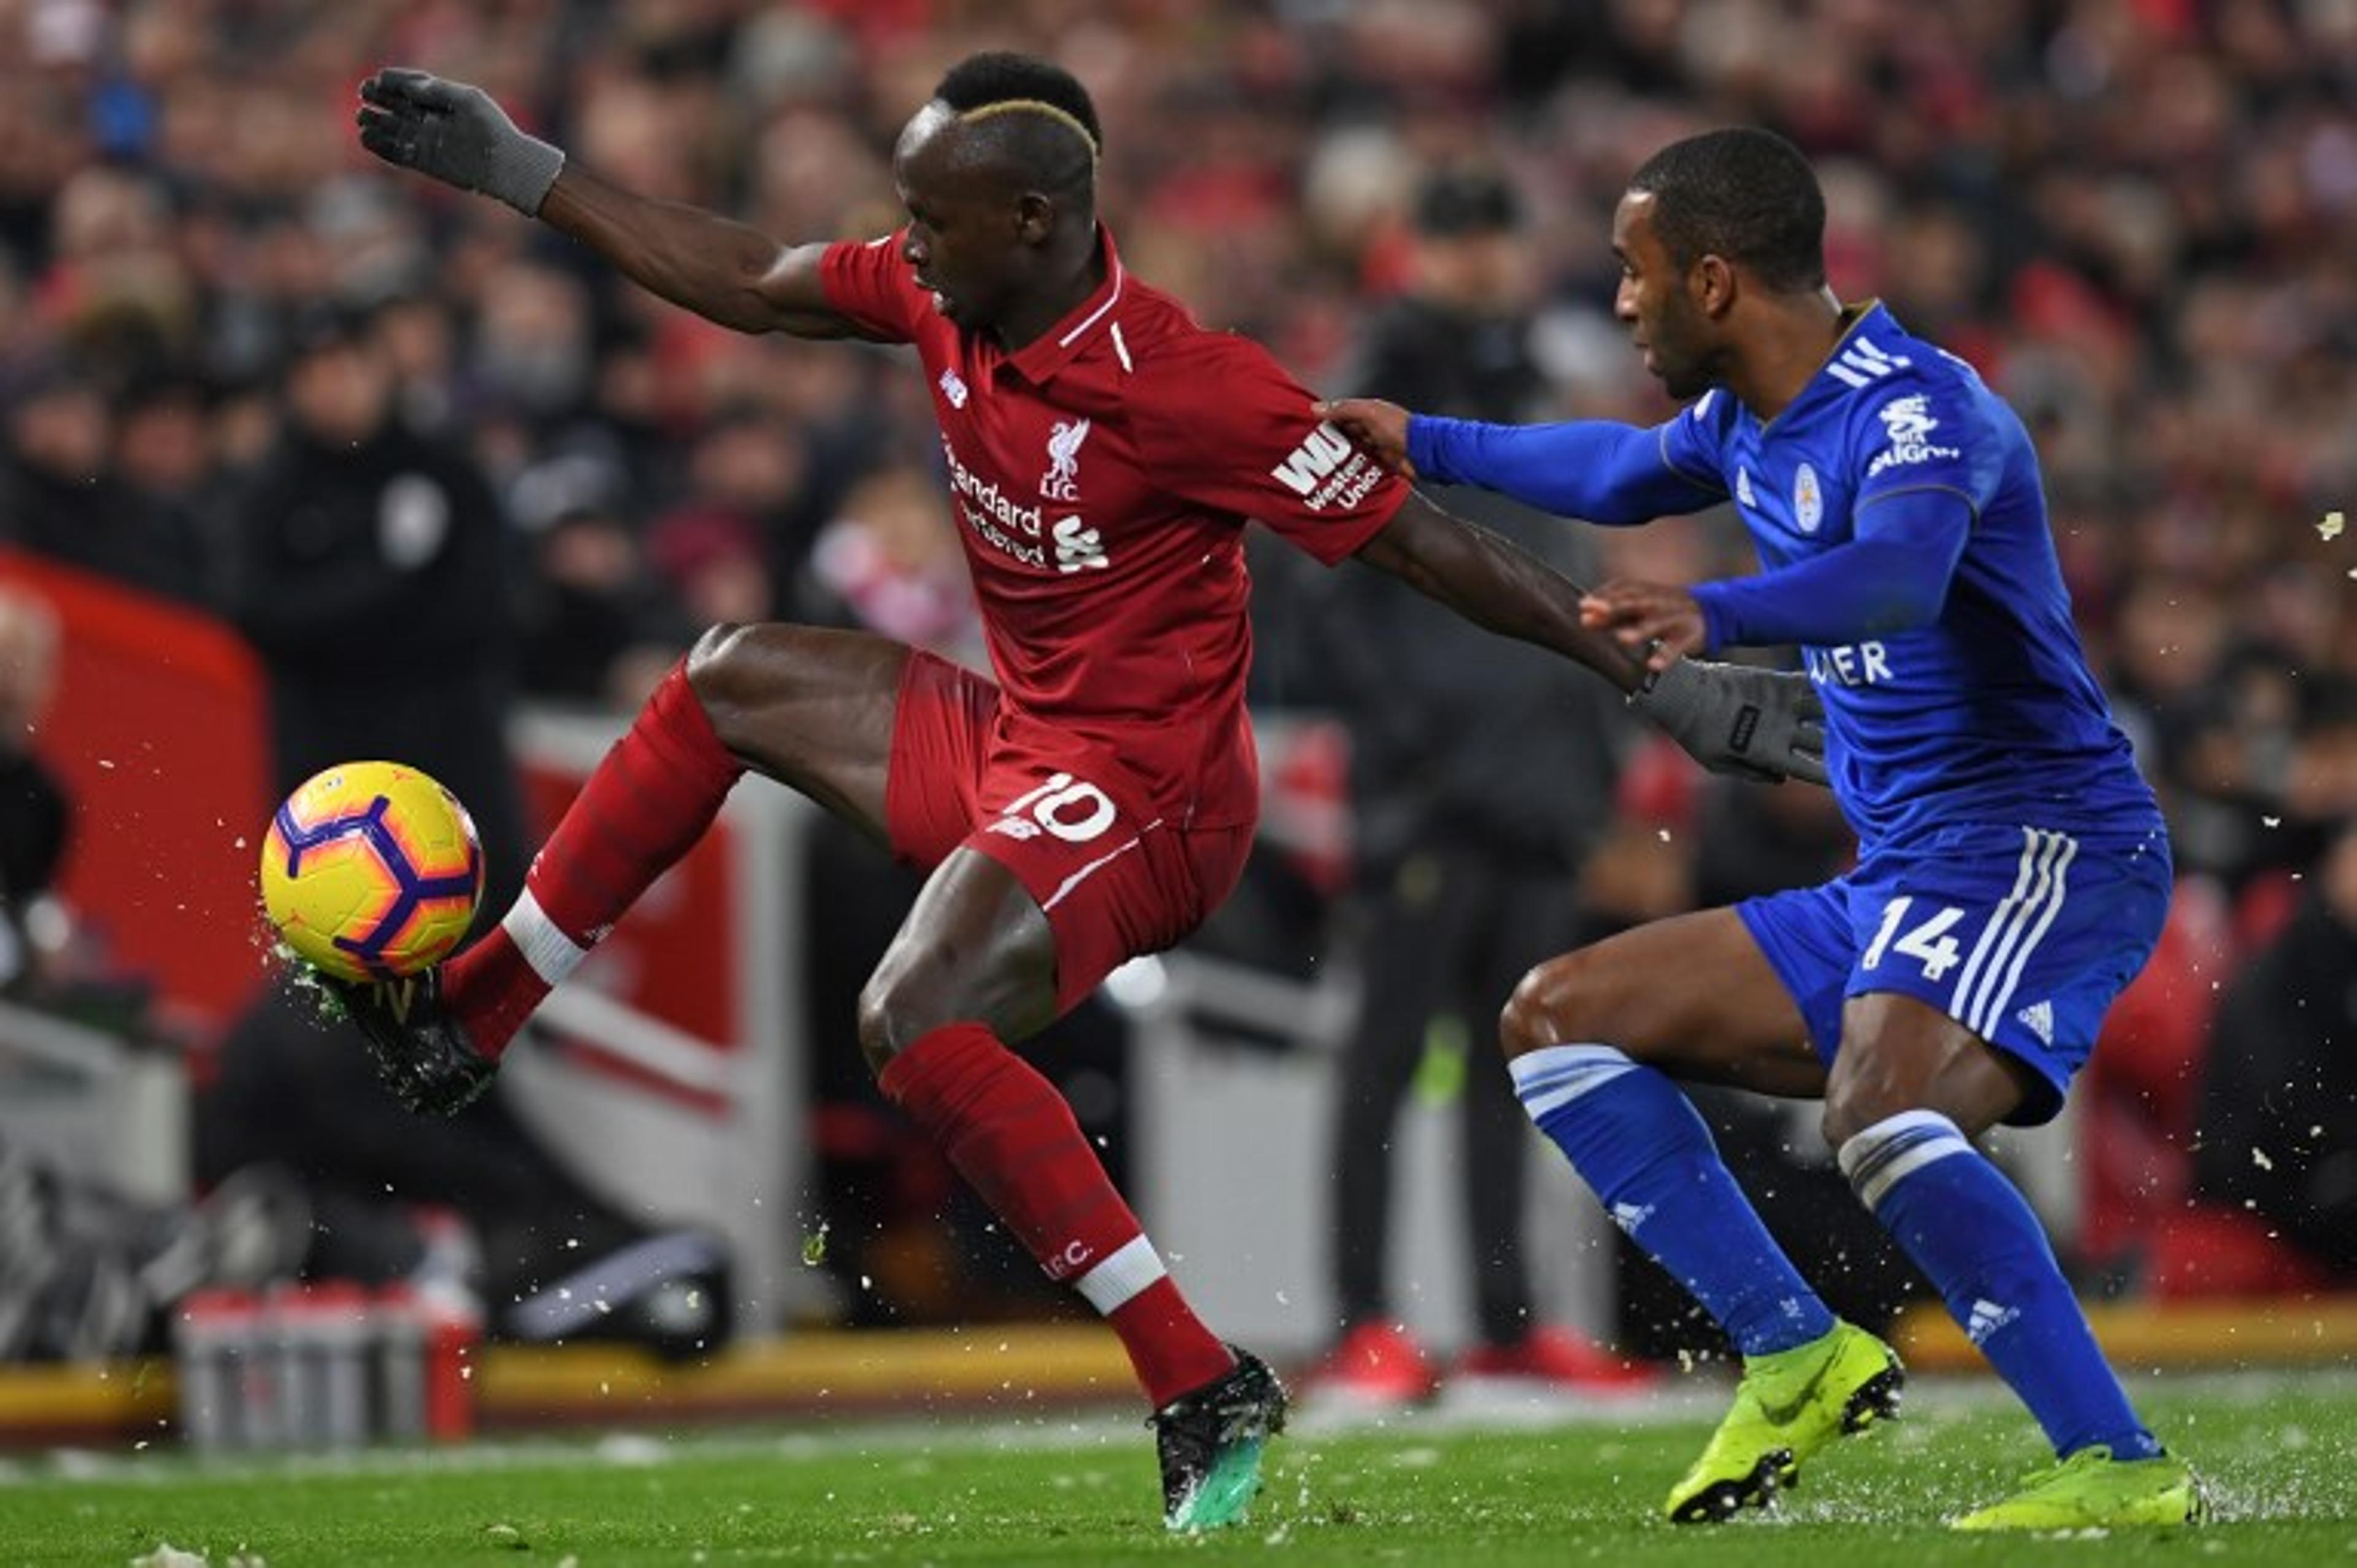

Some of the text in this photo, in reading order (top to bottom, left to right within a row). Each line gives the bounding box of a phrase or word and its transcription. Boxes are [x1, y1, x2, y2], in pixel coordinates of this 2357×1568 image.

[1039, 476, 1081, 501] LFC
[1269, 418, 1351, 495] WU
[1002, 773, 1116, 842] 10
[1862, 896, 1965, 981] 14
